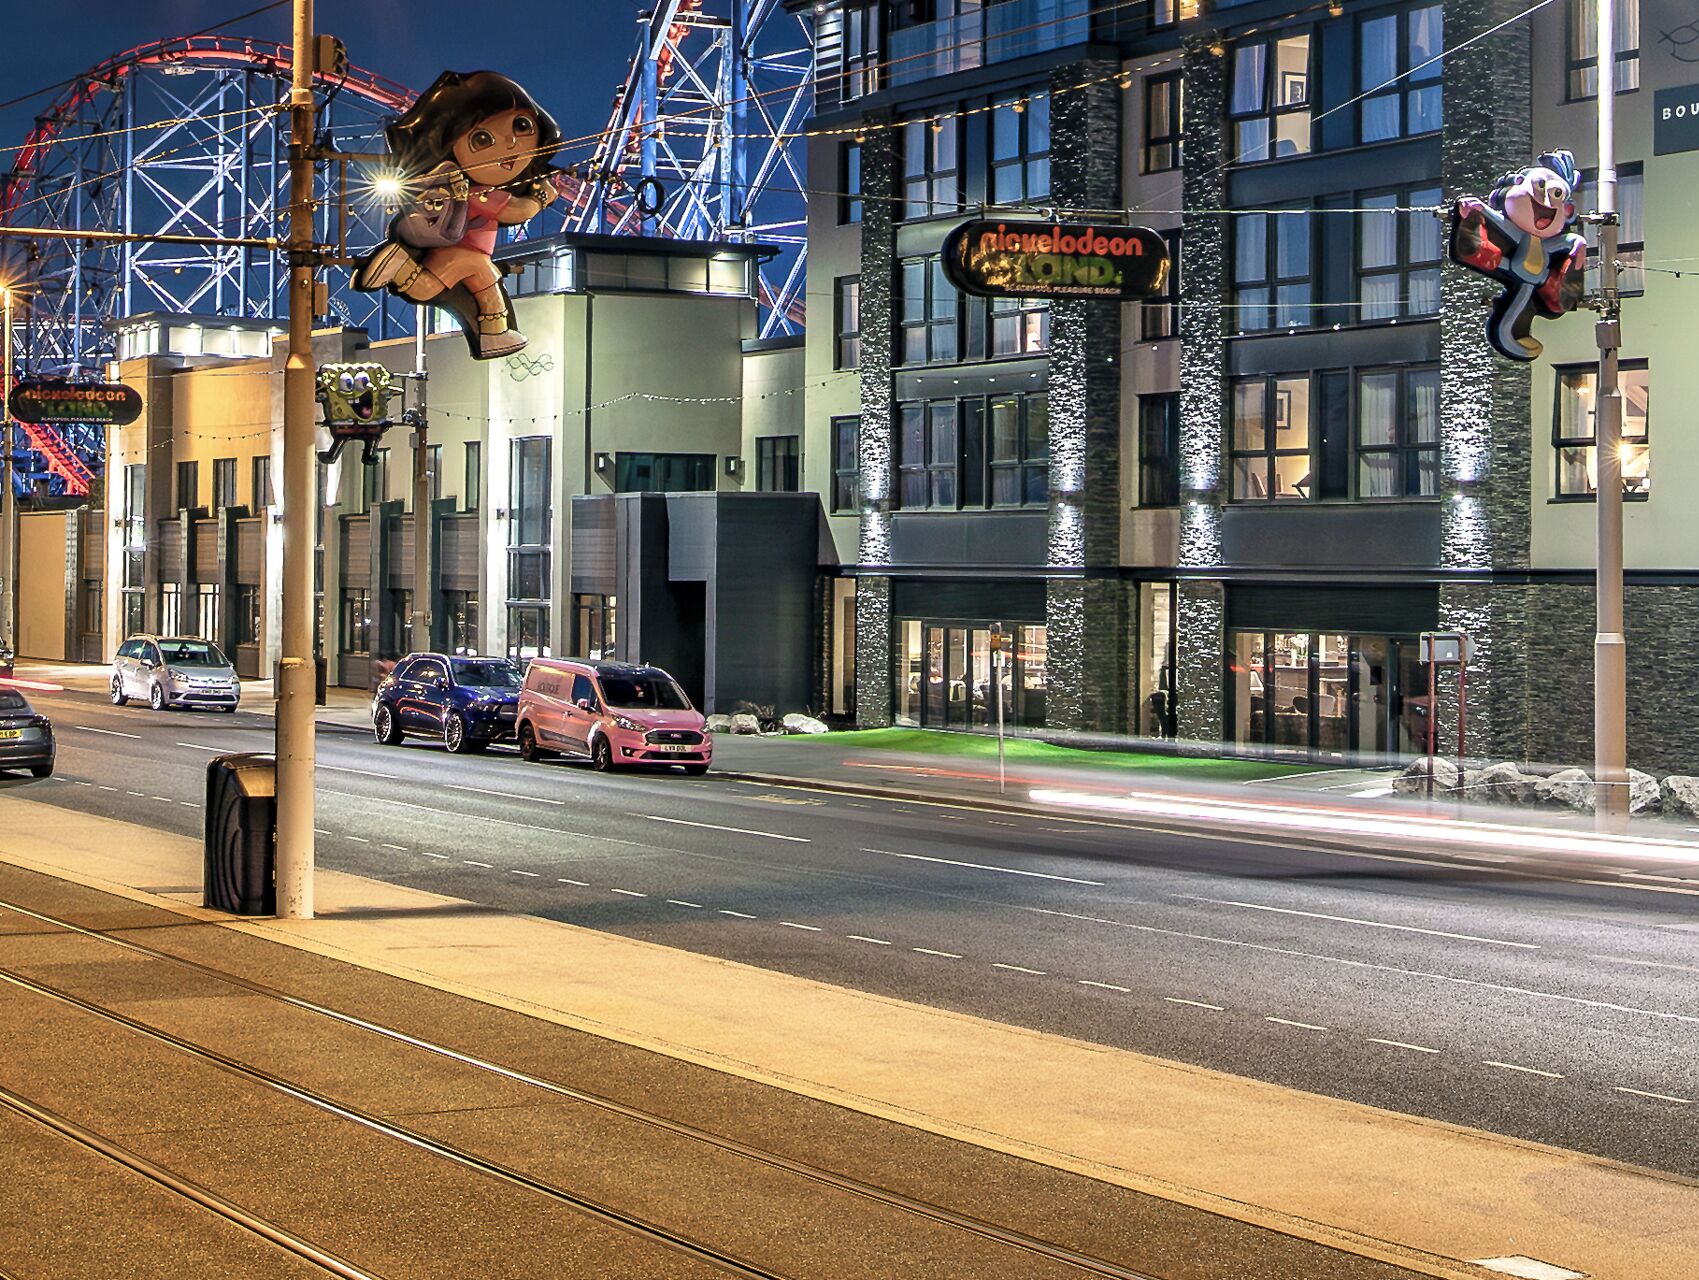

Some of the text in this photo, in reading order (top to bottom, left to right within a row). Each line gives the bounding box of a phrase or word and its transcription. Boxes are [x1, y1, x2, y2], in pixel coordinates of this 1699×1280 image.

[979, 223, 1143, 256] nickelodeon
[1053, 285, 1093, 295] PLEASURE
[1094, 287, 1121, 295] BEACH
